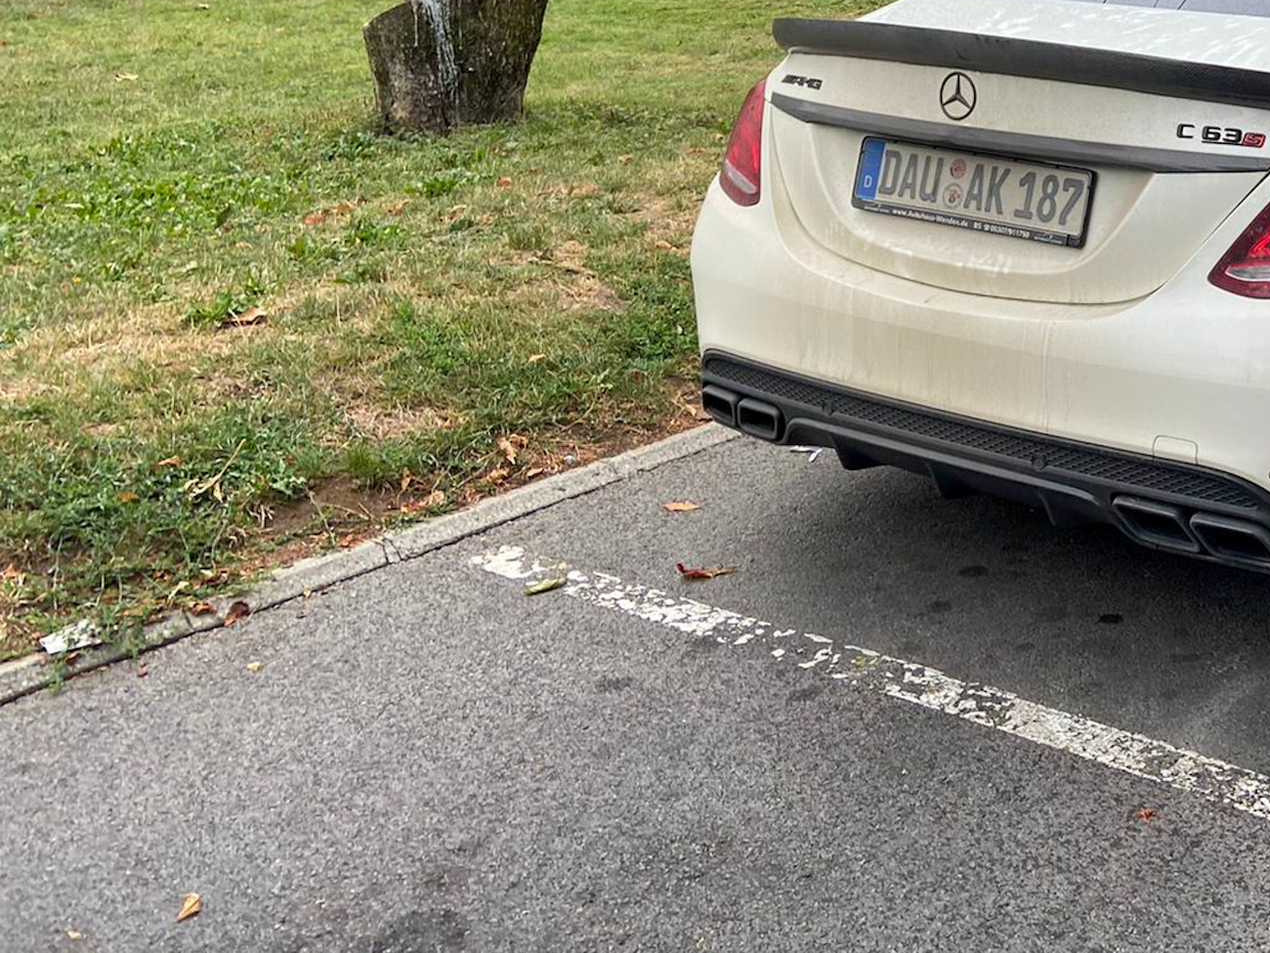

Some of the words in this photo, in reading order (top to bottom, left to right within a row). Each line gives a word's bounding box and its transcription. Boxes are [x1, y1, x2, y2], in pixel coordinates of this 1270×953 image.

[1176, 123, 1195, 139] C
[863, 176, 873, 188] D
[877, 149, 946, 203] DAU
[962, 163, 1011, 215] AK
[1013, 171, 1086, 226] 187
